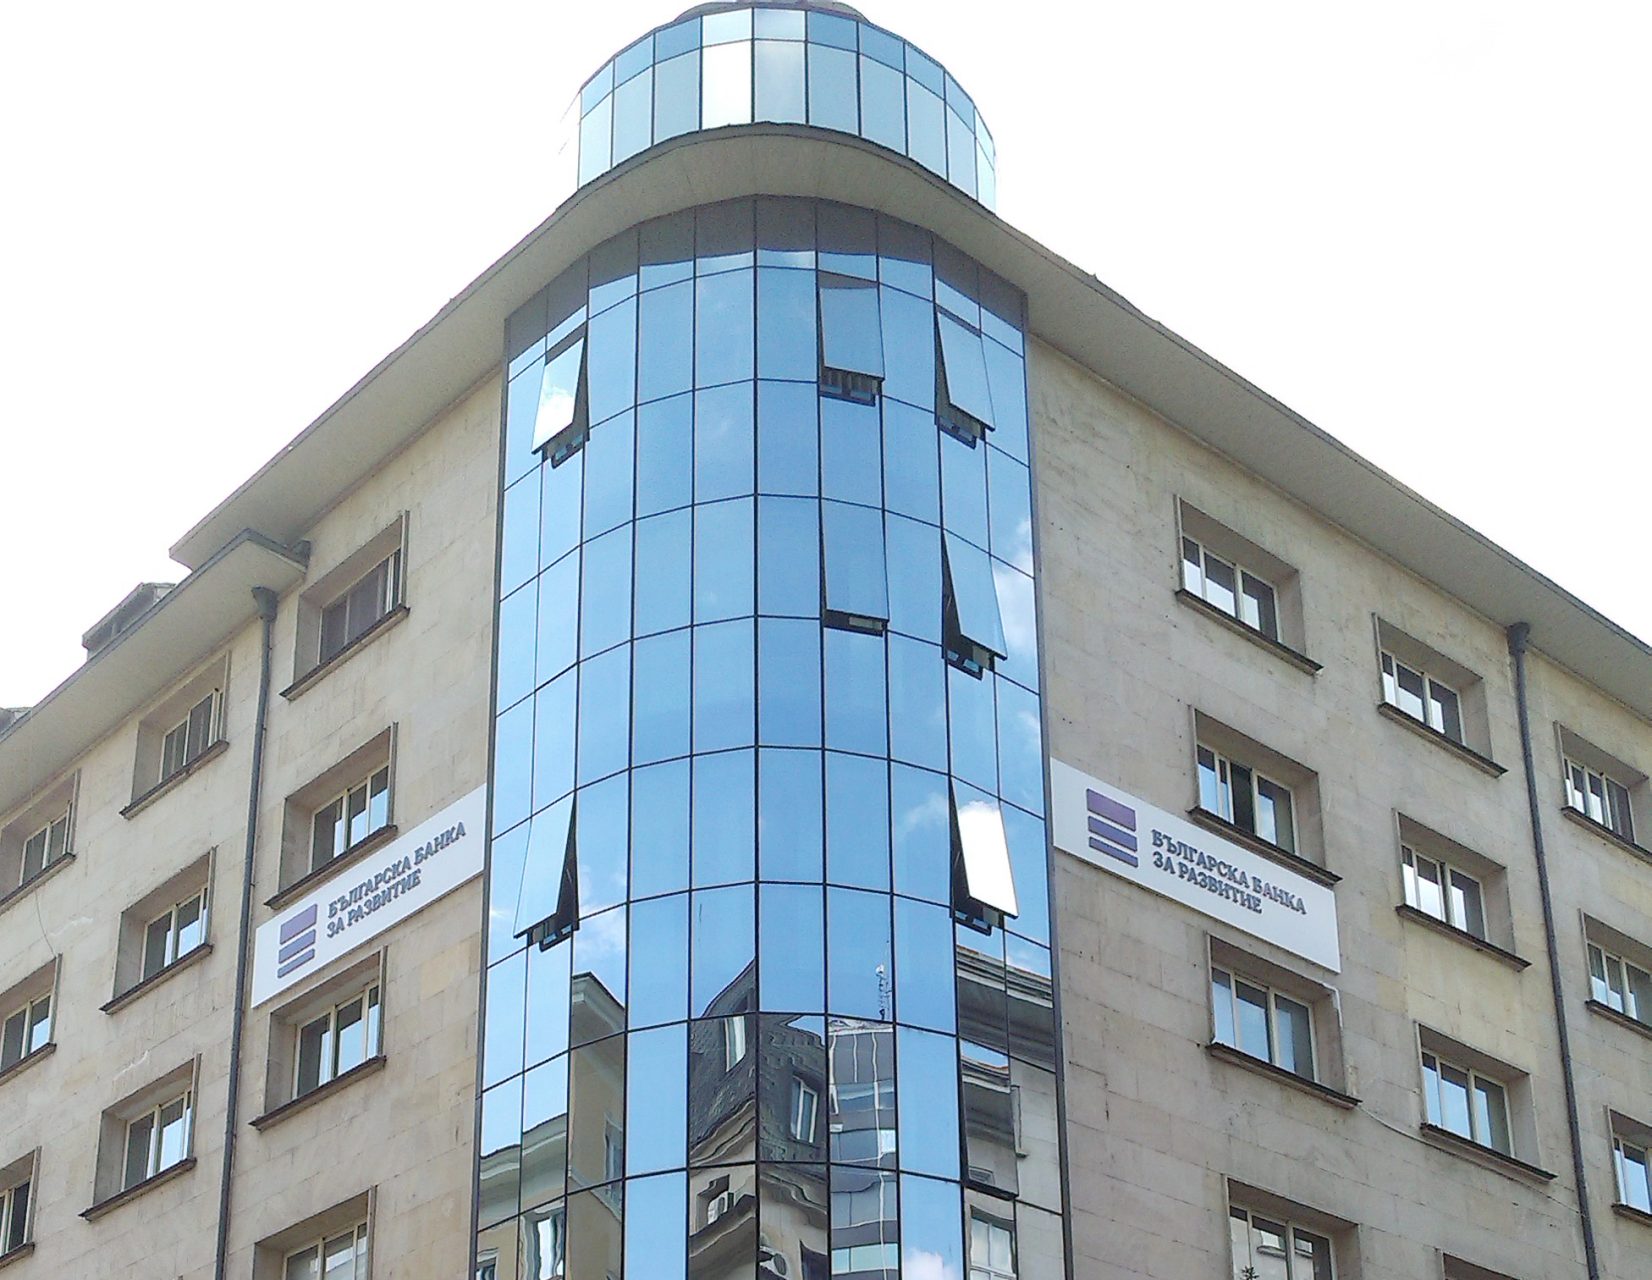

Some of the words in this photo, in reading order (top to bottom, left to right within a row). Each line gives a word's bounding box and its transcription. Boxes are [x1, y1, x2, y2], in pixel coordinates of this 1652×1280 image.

[326, 917, 346, 938] ЗА
[347, 868, 422, 928] РАЗВИТИЕ
[327, 856, 413, 919] БЪЛГАРСКА
[414, 821, 467, 867] БАНКА
[1151, 829, 1250, 889] БЪЛГАРСКА
[1251, 875, 1308, 915] БАНКА
[1153, 851, 1176, 875] ЗА
[1178, 866, 1263, 914] РАЗВИТИЕ
